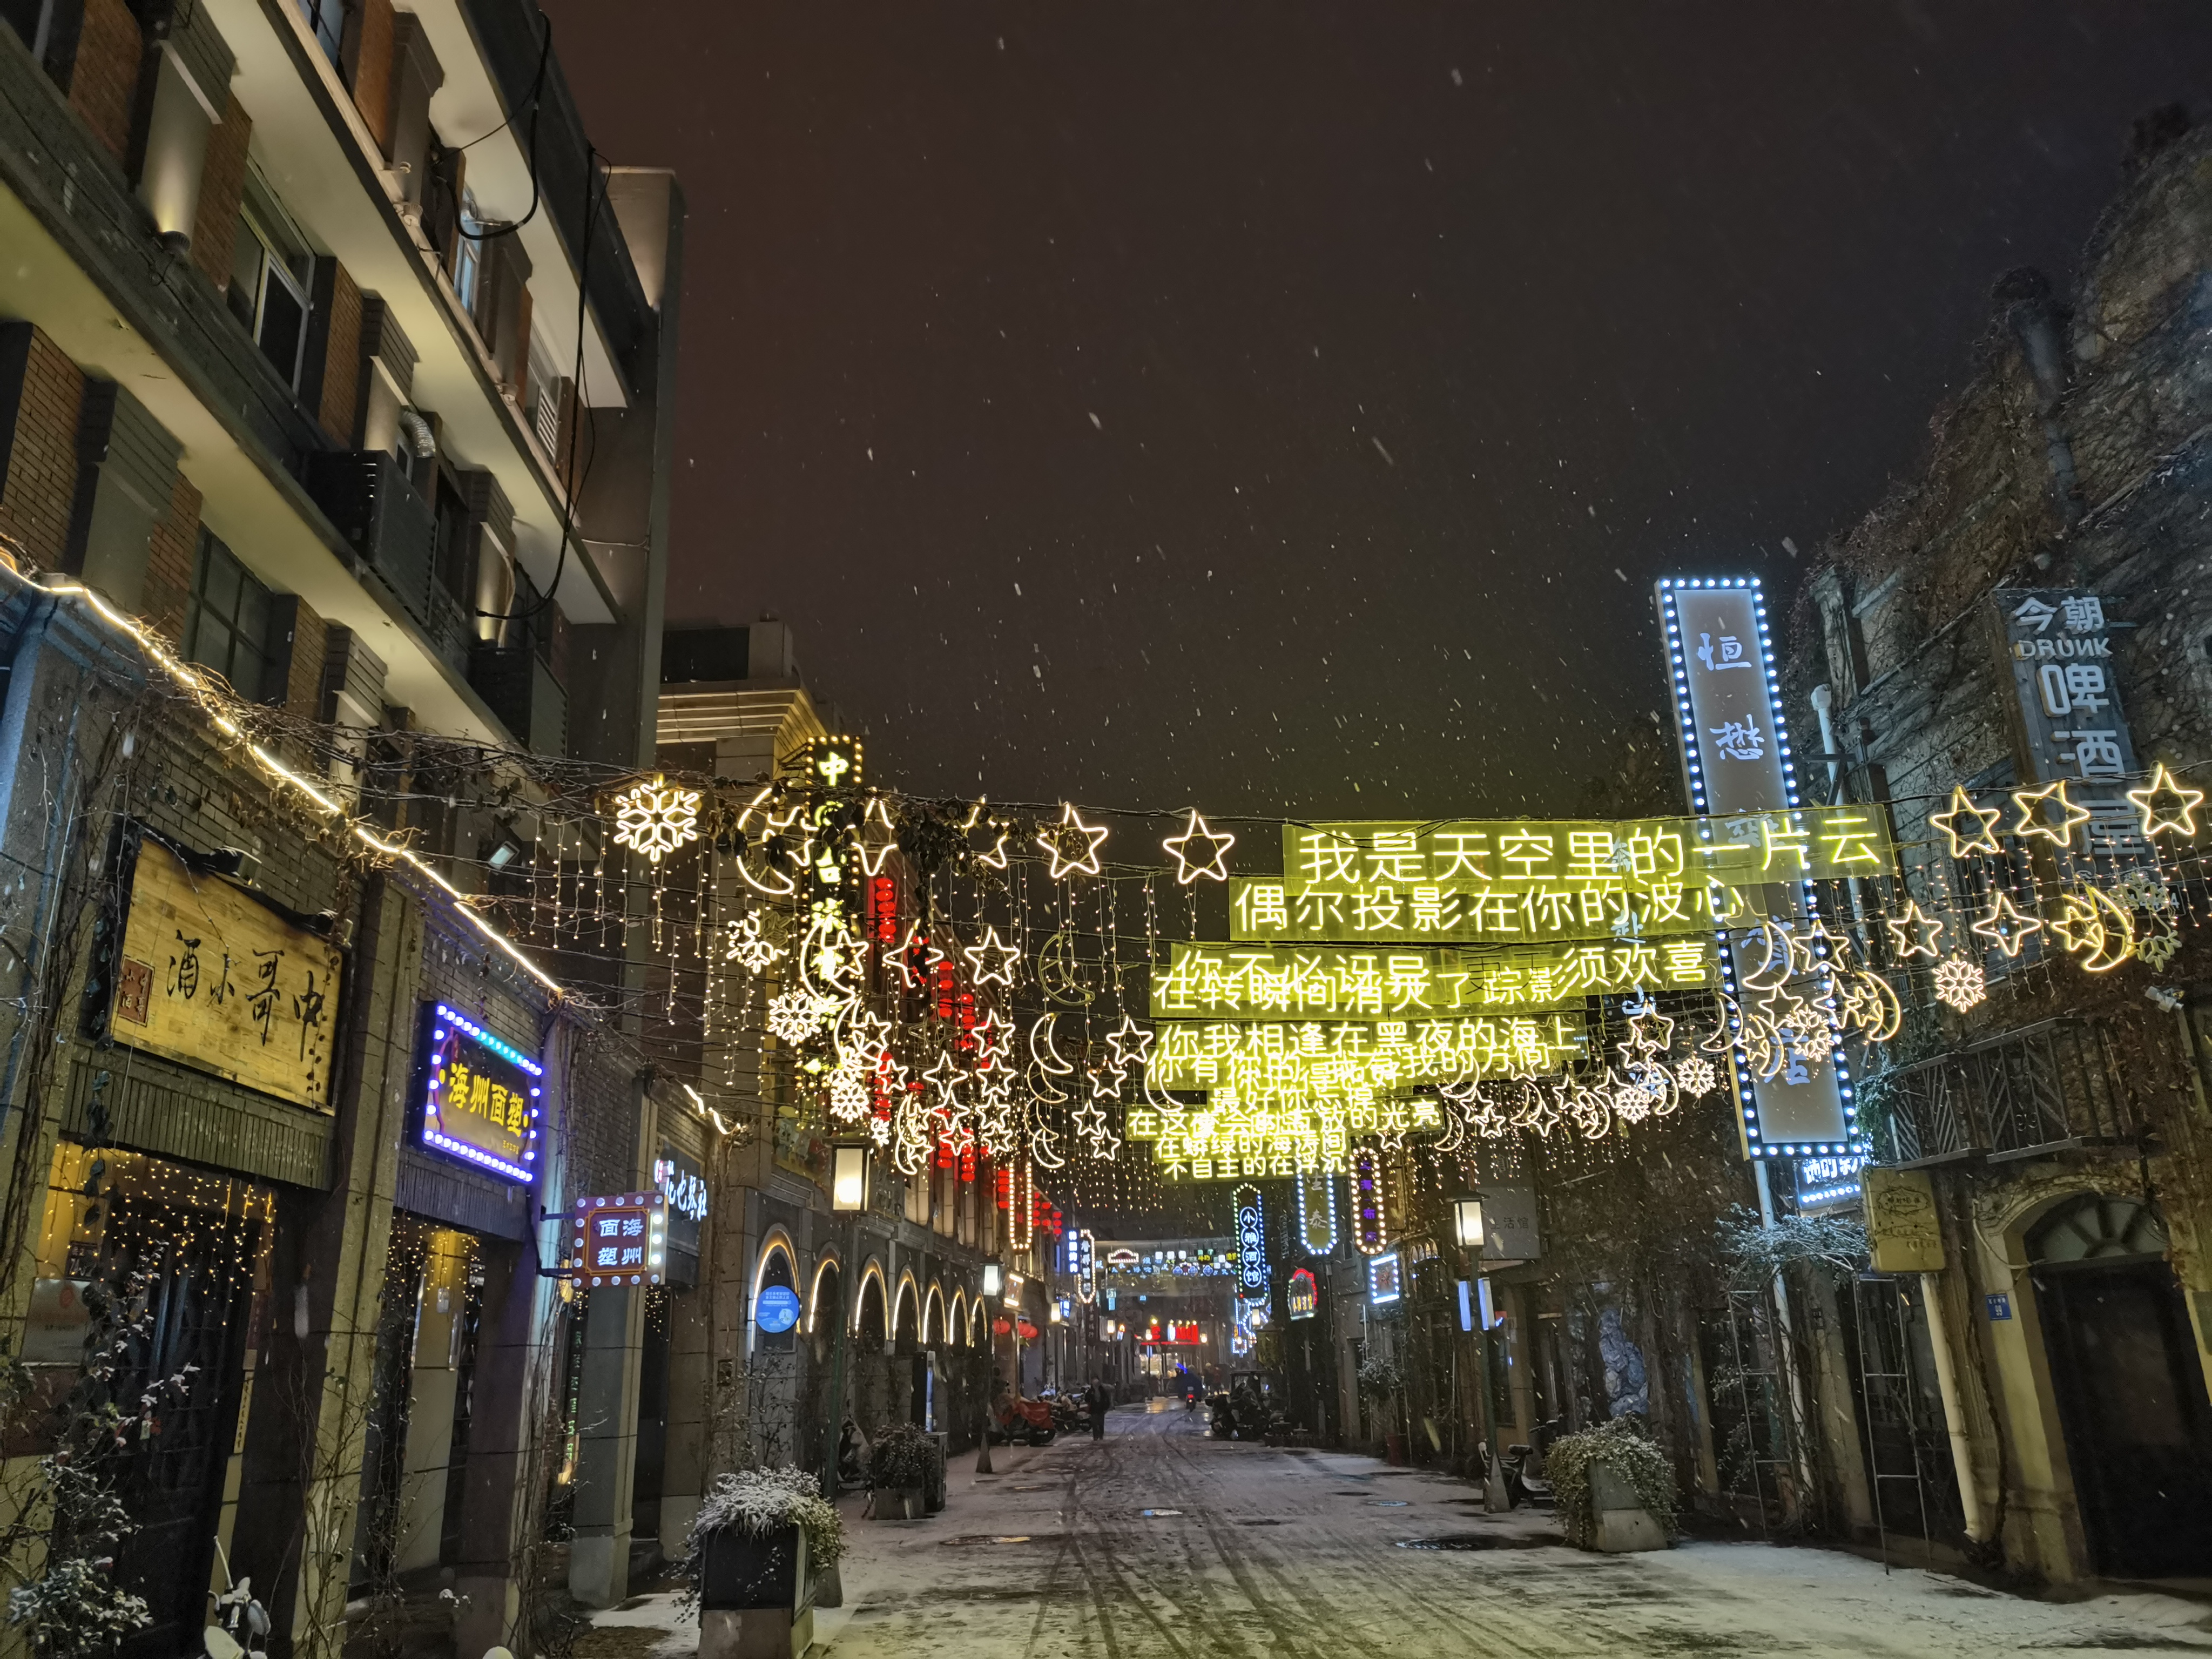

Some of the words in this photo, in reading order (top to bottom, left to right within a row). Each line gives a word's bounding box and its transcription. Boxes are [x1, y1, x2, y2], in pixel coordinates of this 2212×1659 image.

[2012, 596, 2106, 633] 今朝
[2036, 663, 2145, 855] 啤酒屋
[1299, 817, 1880, 884] 我是天空里的一片云
[1235, 875, 1745, 933] 偶尔投影在你的波心
[1160, 1016, 1581, 1060] 你我相逢在黑夜的海上
[448, 1062, 524, 1137] 海州面塑
[1163, 1152, 1347, 1181] 不自主的在浮沉
[1243, 1211, 1260, 1283] 小雅酒馆
